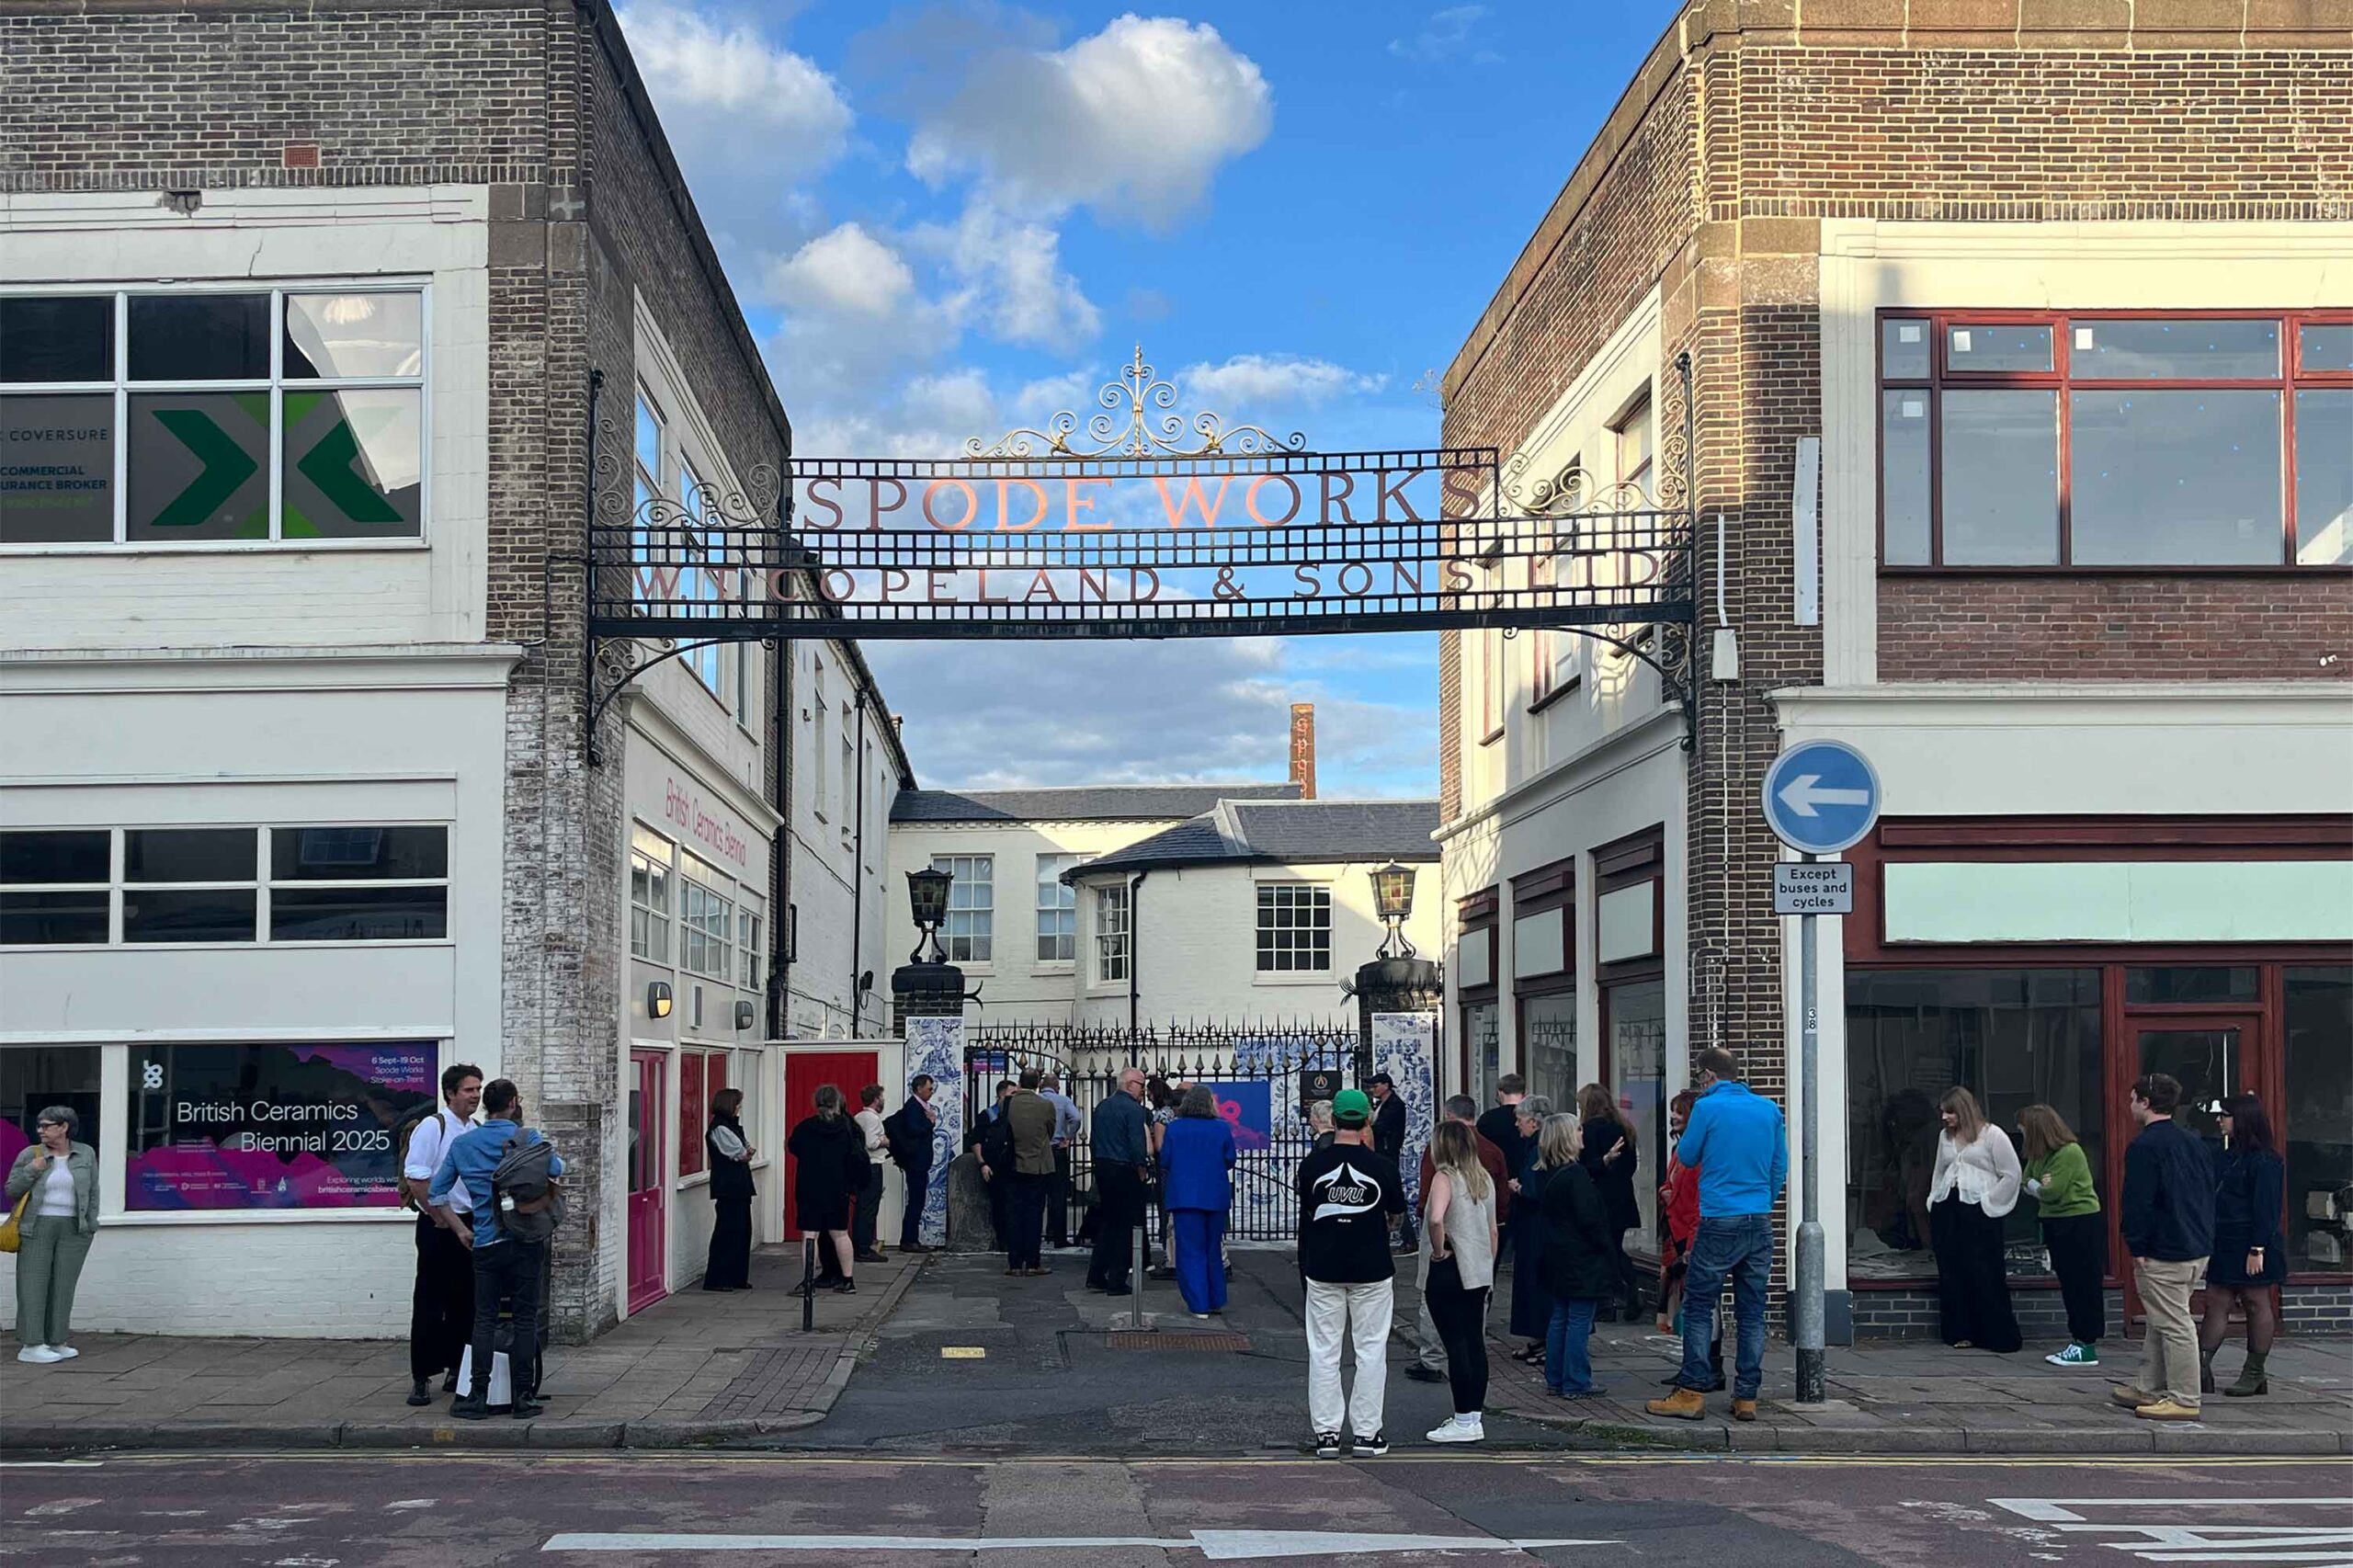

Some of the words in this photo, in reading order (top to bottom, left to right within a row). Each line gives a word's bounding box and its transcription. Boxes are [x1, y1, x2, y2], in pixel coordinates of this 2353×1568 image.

[9, 429, 108, 441] COVERSURE
[0, 466, 85, 476] COMMERCIAL
[55, 479, 107, 490] BROKER
[803, 476, 1115, 532] SPODE
[1154, 468, 1481, 528] WORKS
[1212, 565, 1245, 600] &
[1293, 557, 1474, 597] SONS
[1528, 551, 1660, 590] LTD
[665, 777, 689, 831] British
[692, 796, 723, 854] Ceramics
[724, 820, 747, 869] Biennial
[1790, 869, 1837, 881] Except
[1779, 883, 1818, 893] buses
[1823, 882, 1847, 893] and
[1792, 896, 1835, 909] cycles
[409, 1056, 425, 1064] Oct
[375, 1066, 399, 1074] Spode
[176, 1101, 244, 1123] British
[251, 1100, 358, 1121] Ceramics
[241, 1131, 326, 1153] Biennial
[331, 1130, 391, 1152] 2025
[326, 1176, 360, 1185] Exploring
